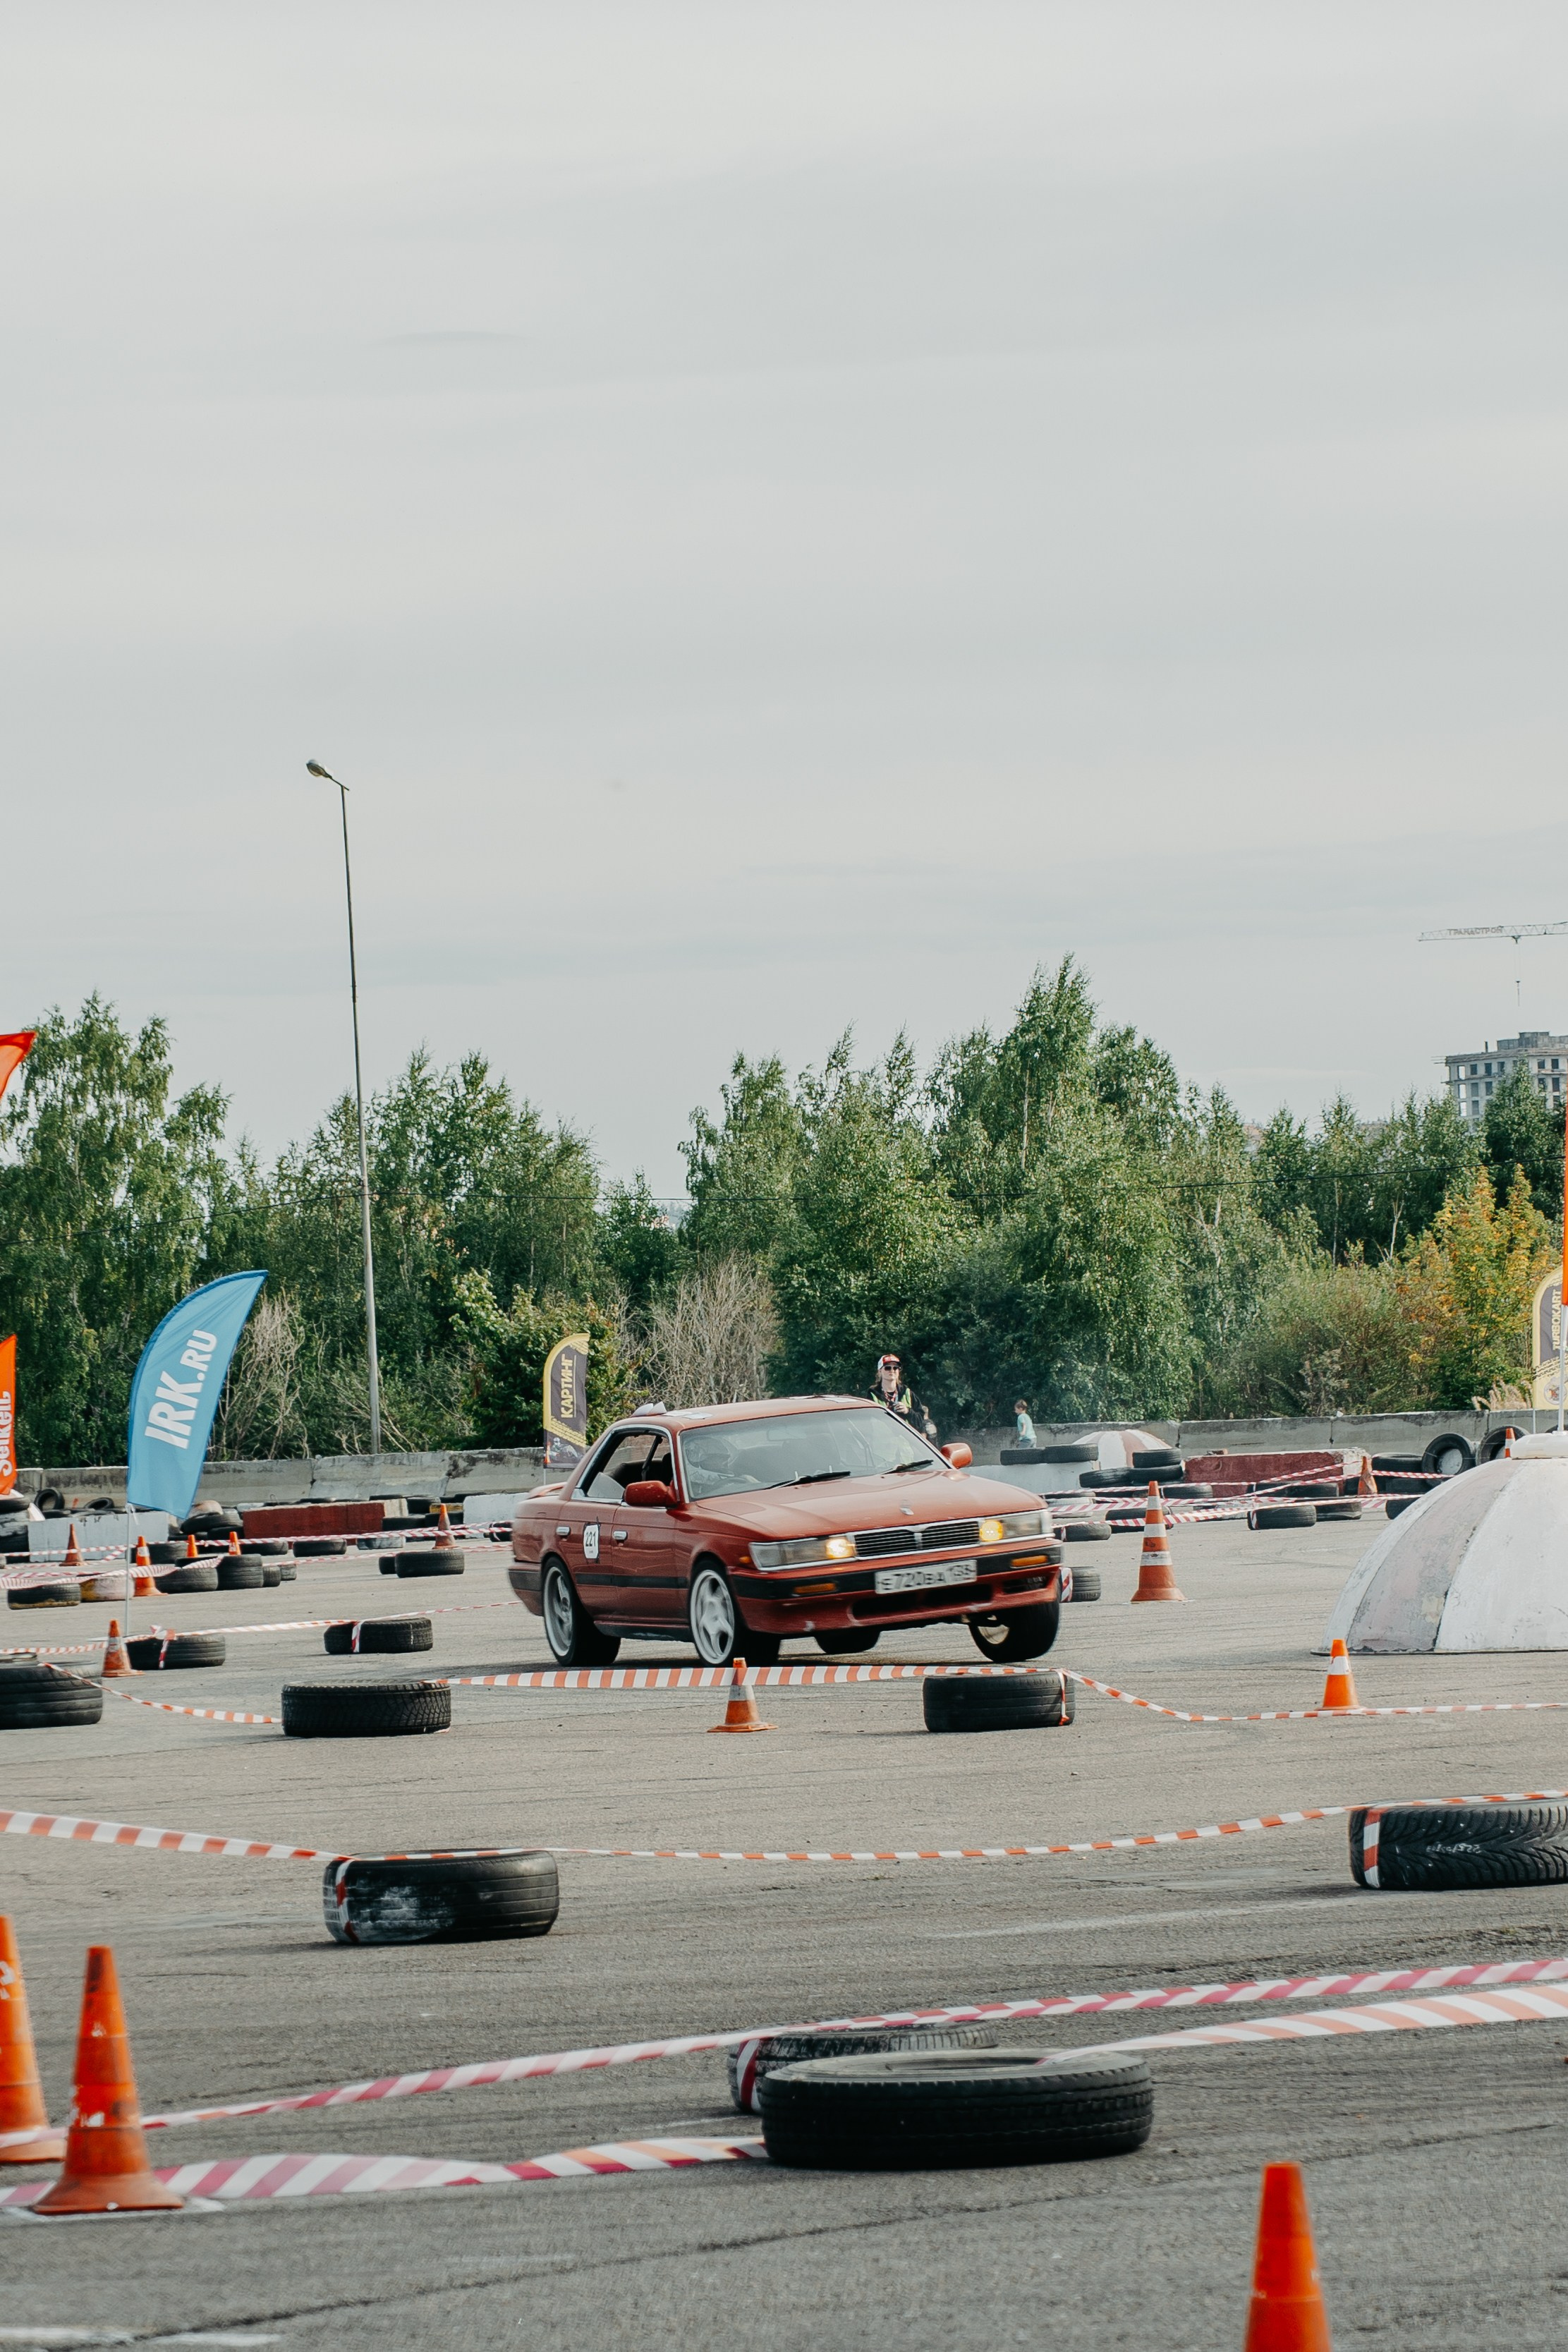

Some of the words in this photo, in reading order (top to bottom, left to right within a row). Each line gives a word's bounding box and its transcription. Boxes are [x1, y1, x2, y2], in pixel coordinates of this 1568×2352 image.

[1551, 1289, 1561, 1350] TURBOKART
[145, 1329, 217, 1450] IRK.RU
[561, 1354, 573, 1419] КАРТИНГ
[585, 1531, 596, 1547] 221
